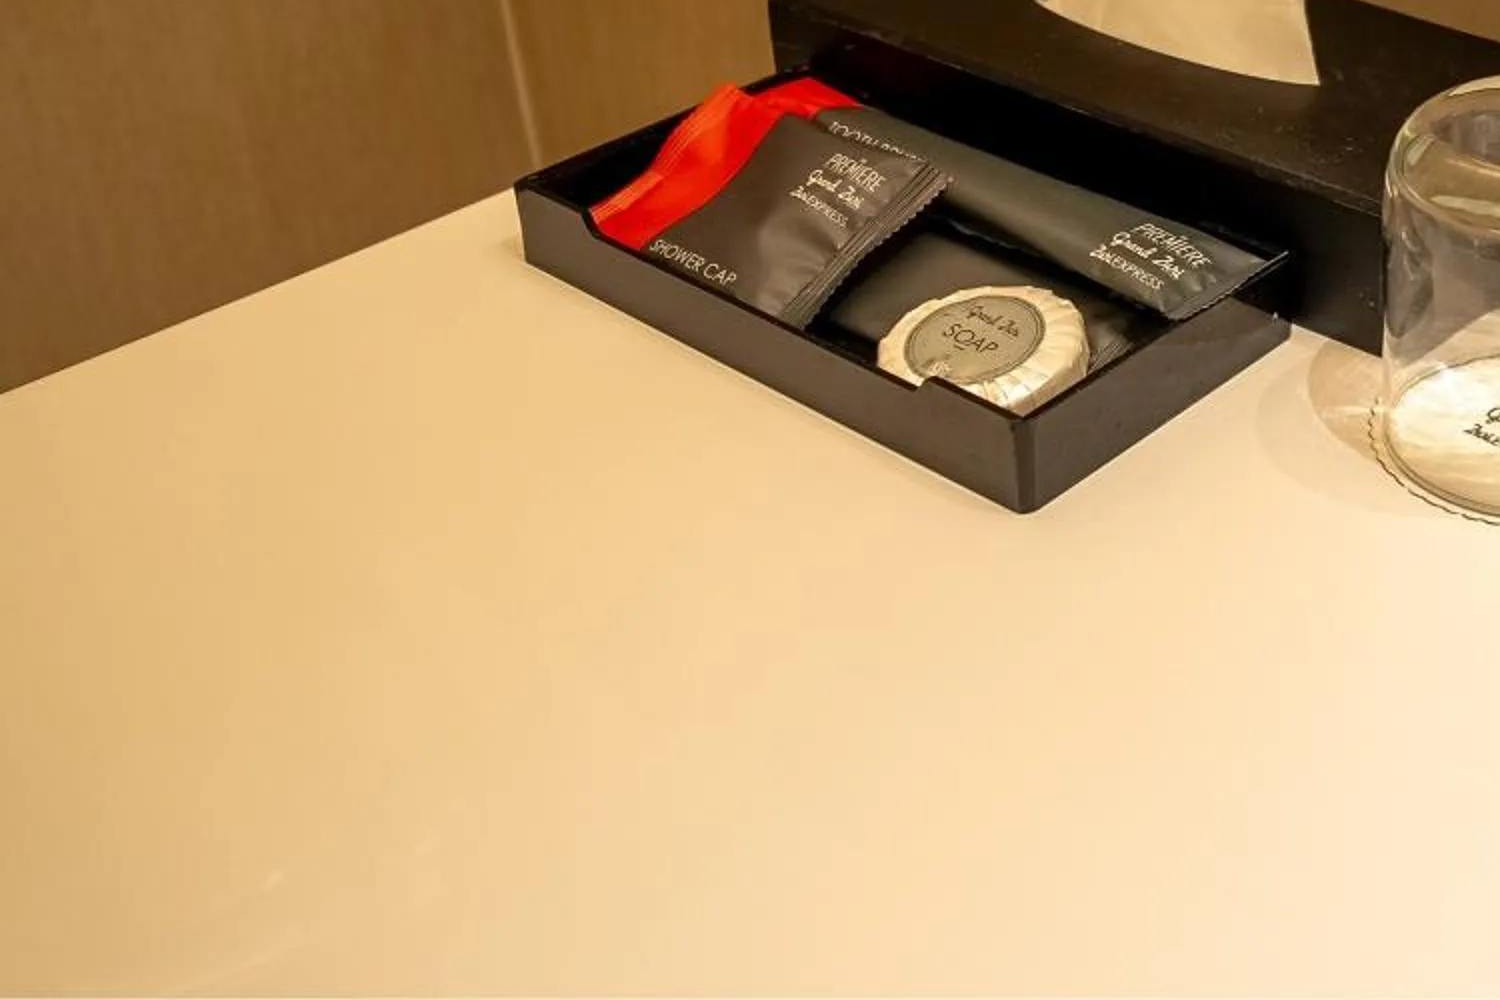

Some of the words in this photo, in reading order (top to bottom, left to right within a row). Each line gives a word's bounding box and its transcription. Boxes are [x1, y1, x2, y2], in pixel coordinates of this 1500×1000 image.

[649, 239, 705, 272] SHOWER
[703, 263, 737, 286] CAP
[943, 323, 999, 353] SOAP
